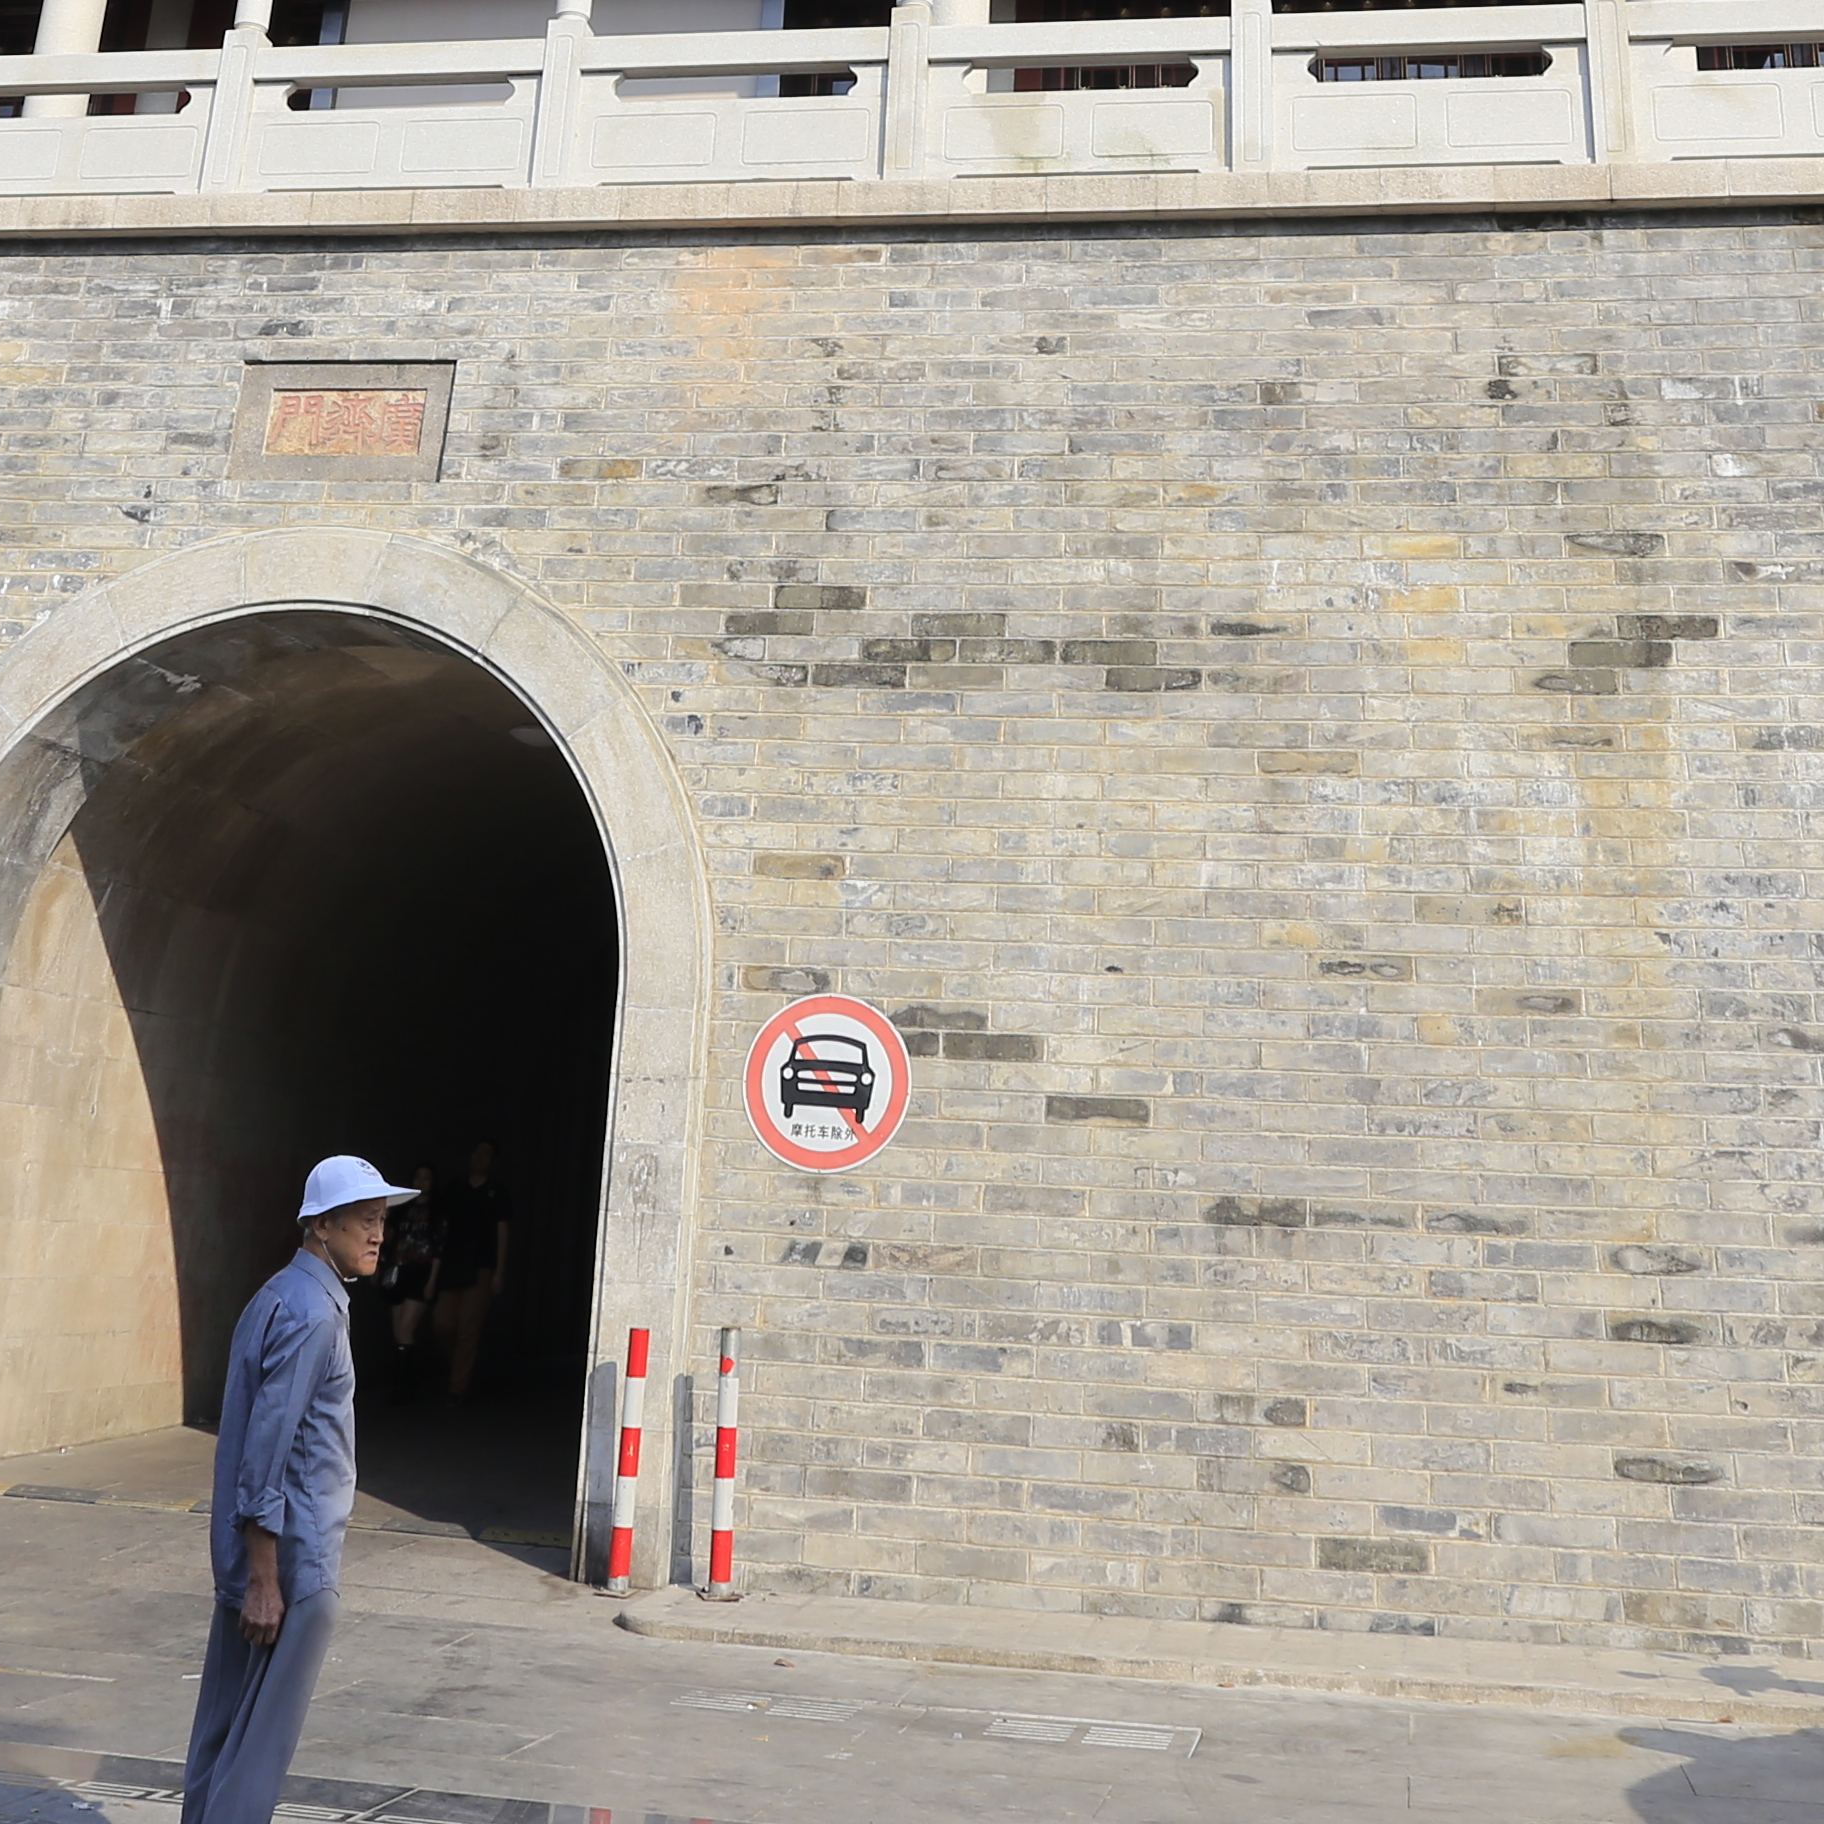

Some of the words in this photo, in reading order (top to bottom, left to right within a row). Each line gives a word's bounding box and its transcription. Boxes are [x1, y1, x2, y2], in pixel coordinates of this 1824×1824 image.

[789, 1122, 857, 1142] 摩托车除外
